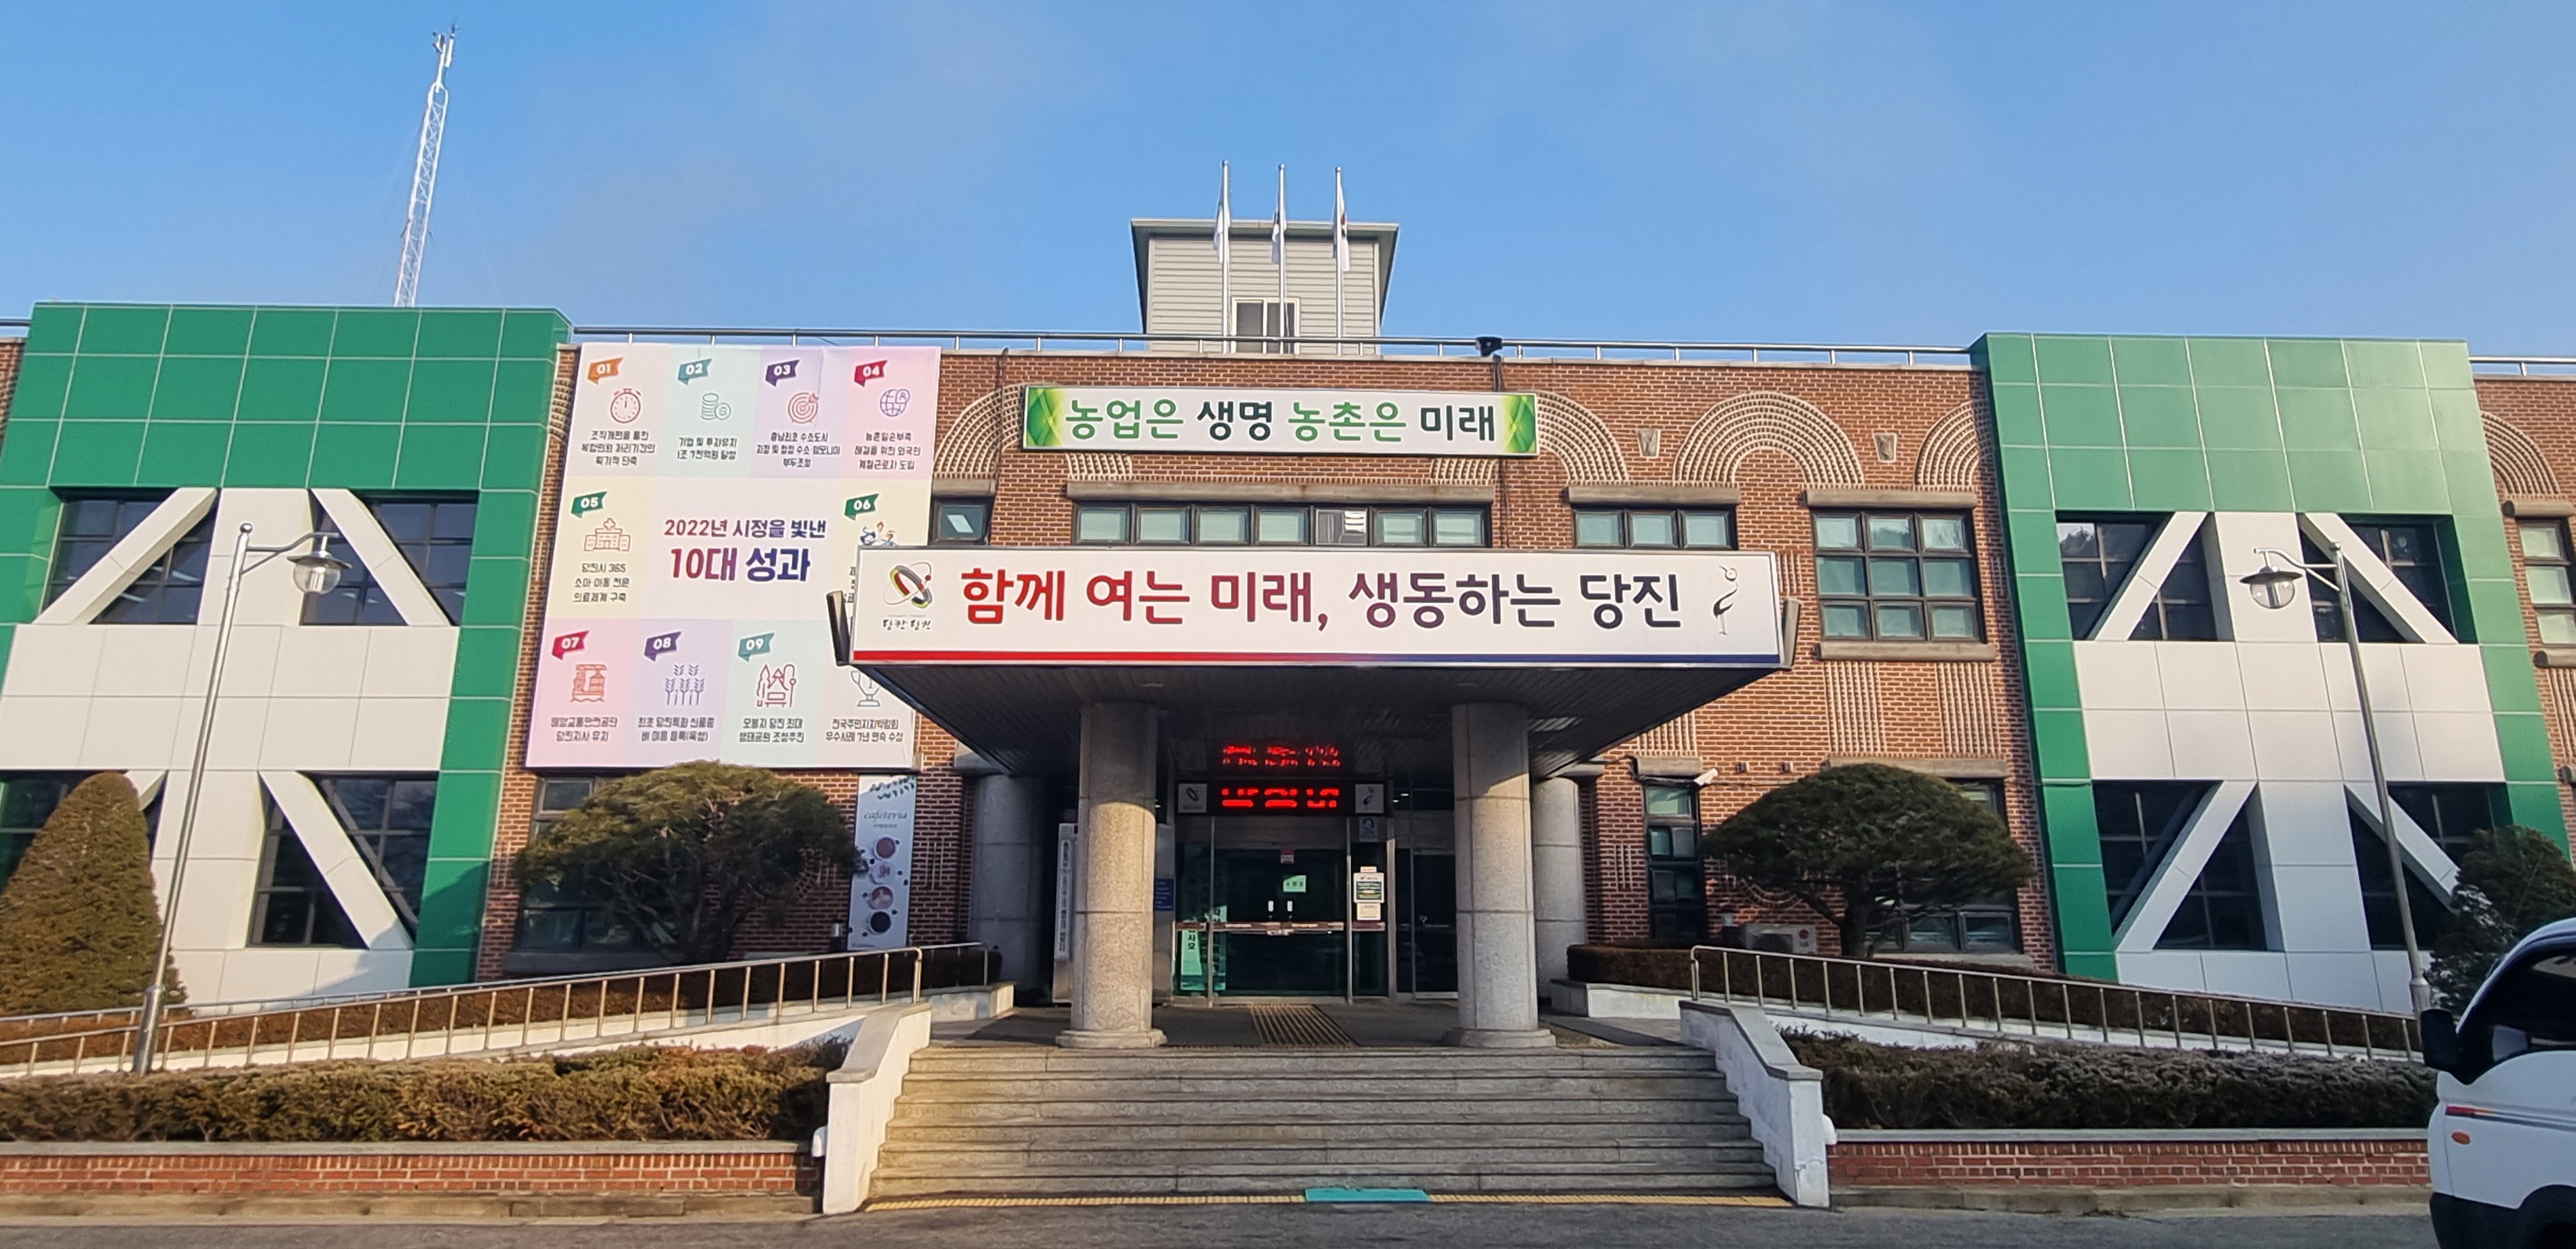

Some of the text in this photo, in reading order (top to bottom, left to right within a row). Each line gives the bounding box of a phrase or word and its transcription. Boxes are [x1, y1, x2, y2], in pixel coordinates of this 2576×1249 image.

[596, 364, 611, 375] 01
[686, 364, 703, 375] 02
[773, 365, 791, 376] 03
[862, 365, 880, 377] 04
[1066, 399, 1495, 442] 농업은 생명 농촌은 미래
[678, 437, 737, 447] 기업 및 투자유치
[801, 432, 829, 442] 수소도시
[900, 460, 915, 470] 도입
[581, 496, 599, 509] 05
[854, 500, 871, 511] 06
[664, 519, 827, 539] 2022년 시정을 빛낸
[671, 548, 811, 582] 10대 성과
[961, 567, 1682, 632] 함께 여는 미래, 생동하는 당진
[561, 636, 580, 649] 07
[653, 637, 671, 650] 08
[746, 638, 764, 651] 09
[888, 732, 903, 742] 수상
[864, 809, 907, 822] cafeteria
